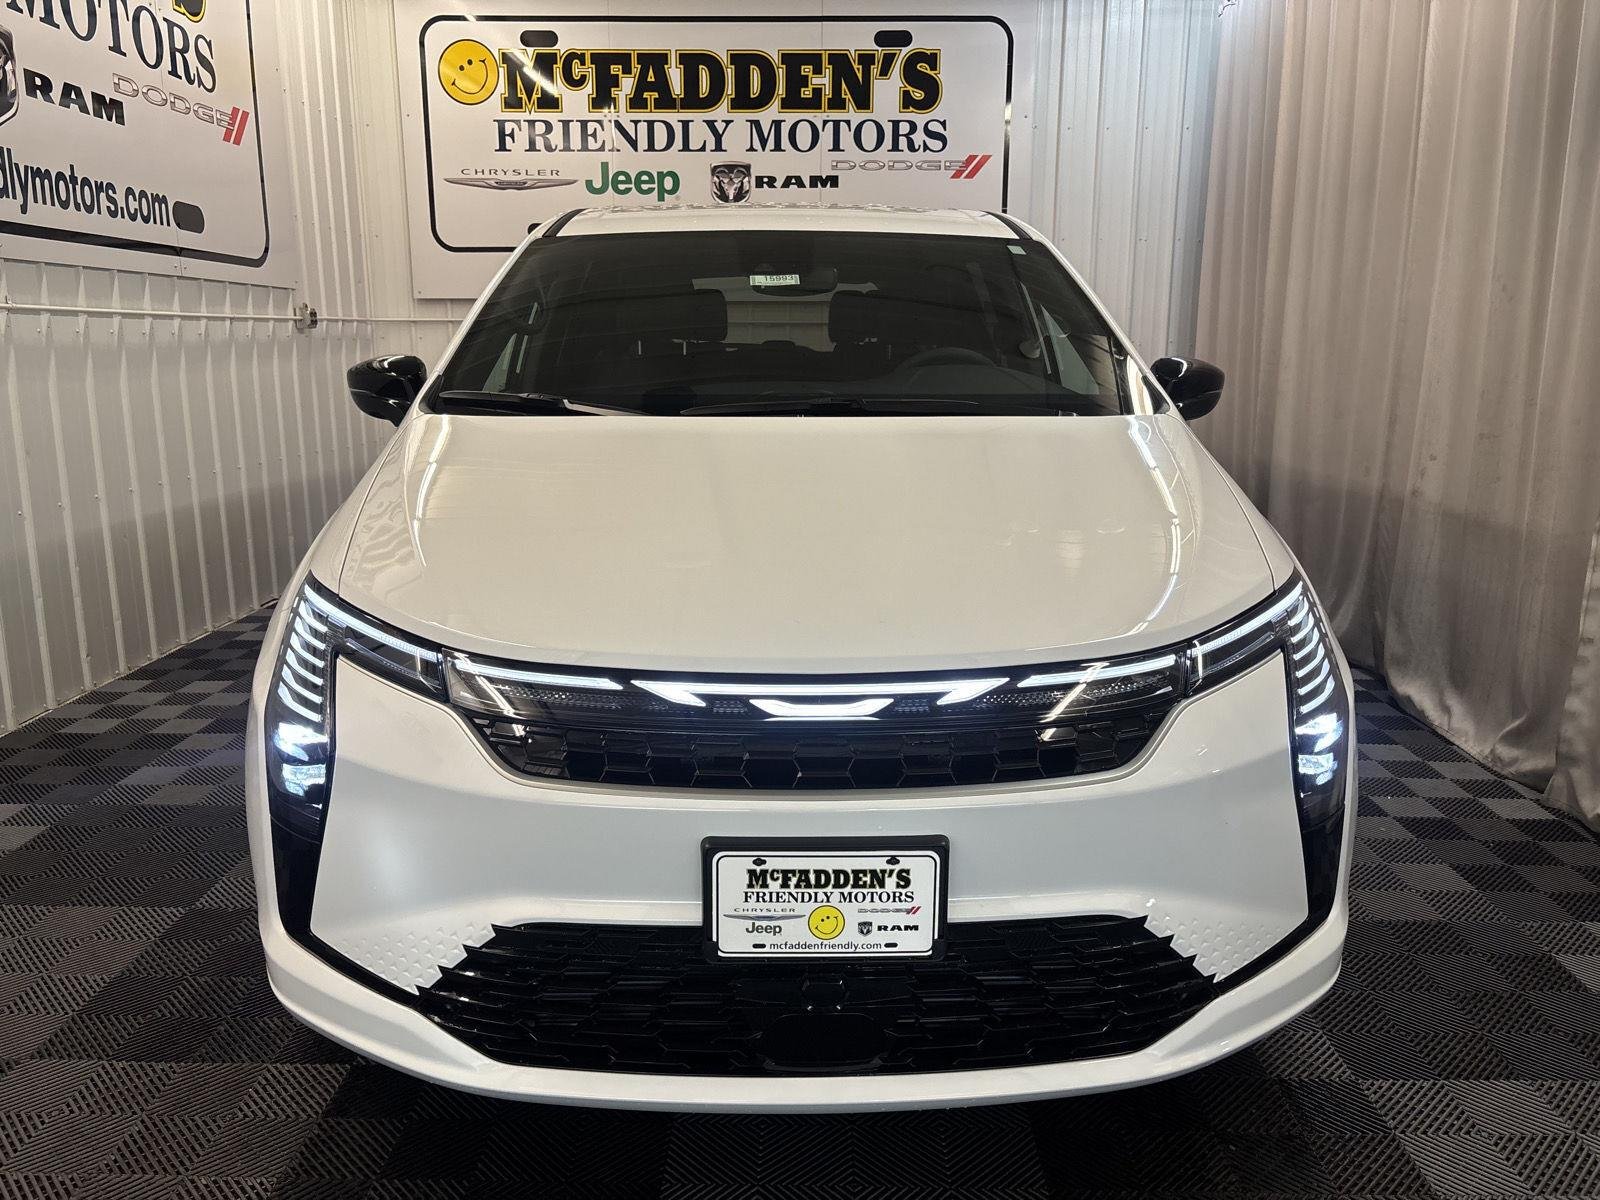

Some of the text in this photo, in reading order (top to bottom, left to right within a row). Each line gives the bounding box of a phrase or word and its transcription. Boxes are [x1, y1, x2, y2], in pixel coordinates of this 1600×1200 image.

[23, 67, 126, 126] RAM
[112, 72, 236, 130] DODGE
[493, 119, 948, 153] FRIENDLY MOTORS
[831, 159, 969, 171] DODGE
[460, 168, 560, 177] CHRYSLER
[585, 161, 681, 202] Jeep
[755, 175, 840, 189] RAM
[742, 890, 915, 904] FRIENDLY MOTORS
[745, 922, 783, 937] Jeep
[877, 924, 919, 932] RAM
[769, 941, 882, 951] mcfaddenfriendly.com
